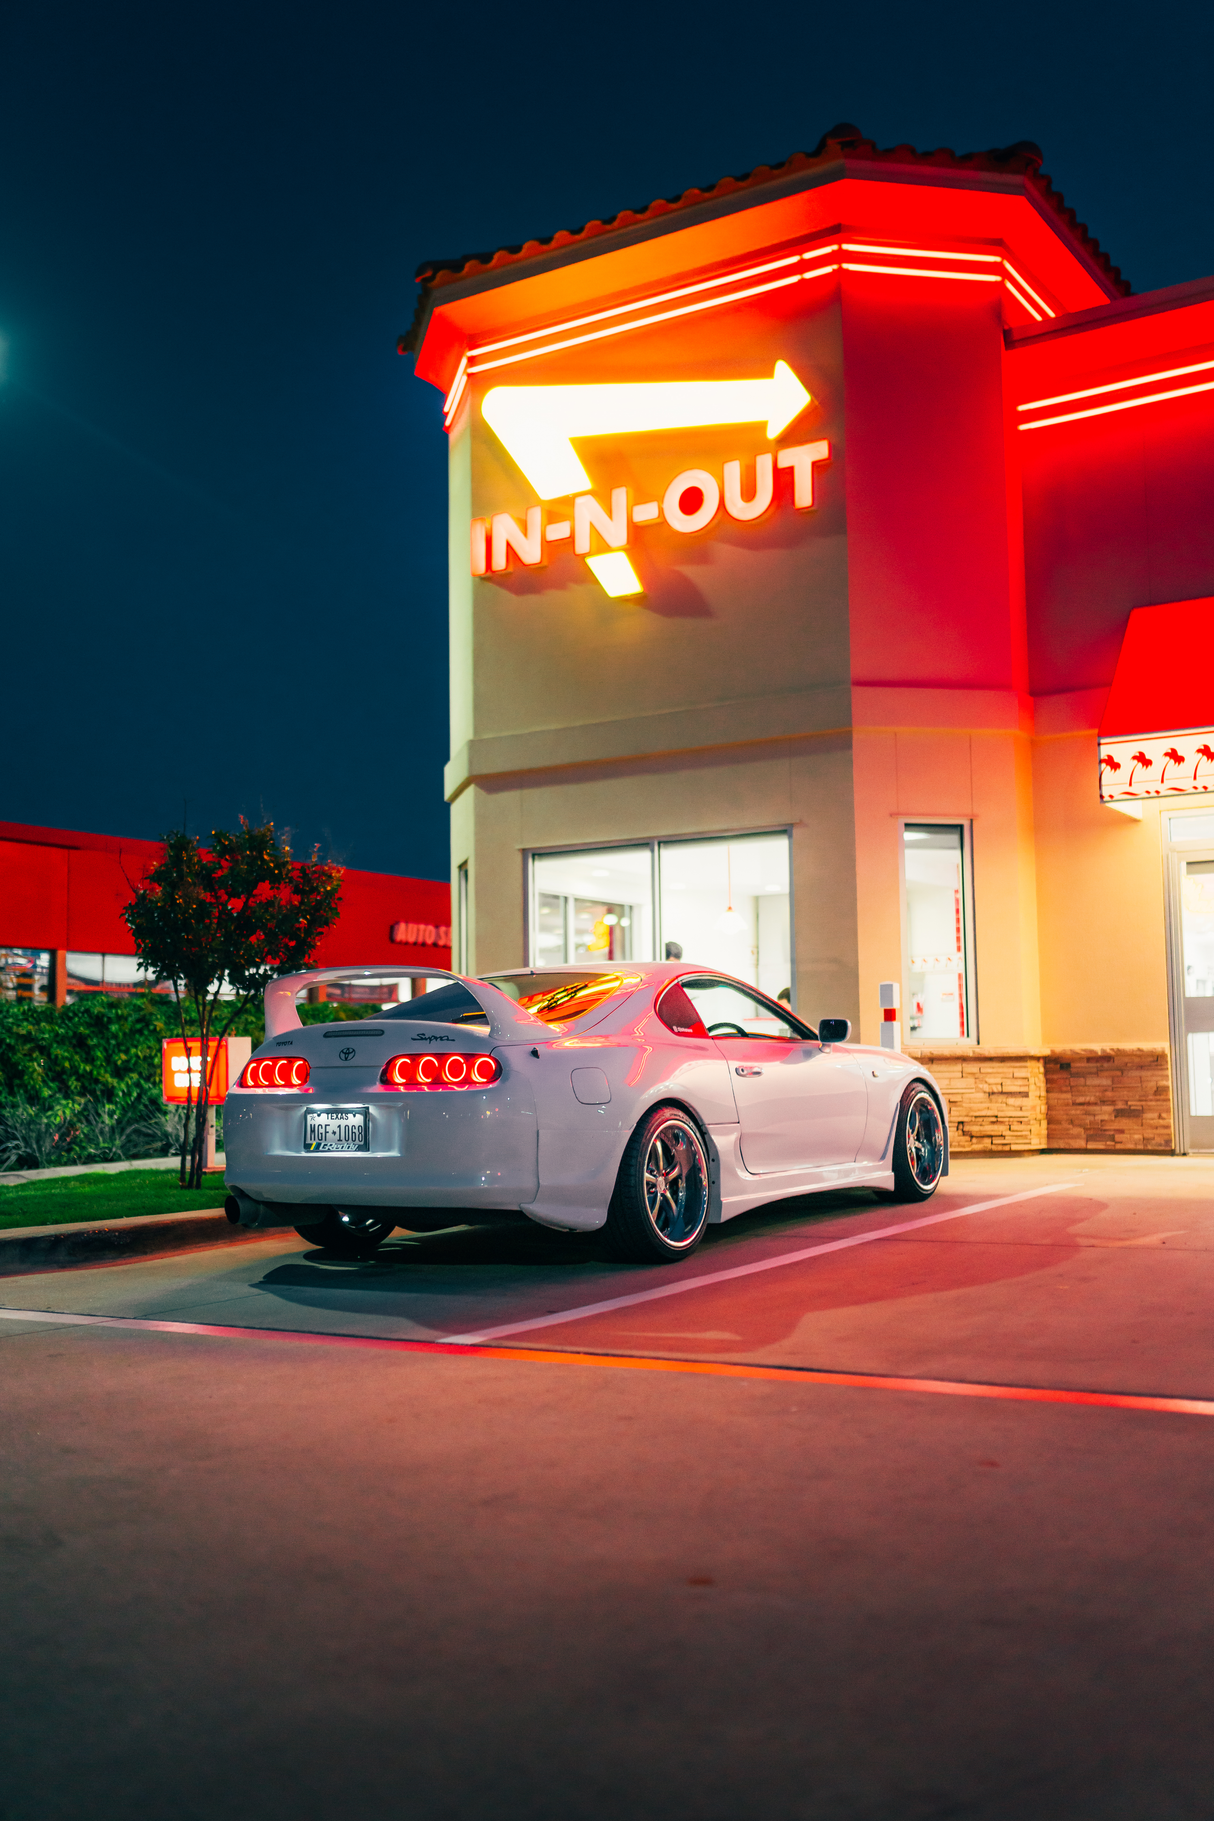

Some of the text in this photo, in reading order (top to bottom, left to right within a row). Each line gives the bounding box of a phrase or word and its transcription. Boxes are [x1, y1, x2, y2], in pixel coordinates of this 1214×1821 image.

[471, 438, 830, 578] IN-N-OUT
[396, 922, 436, 944] AUTO
[411, 1033, 455, 1044] Supra
